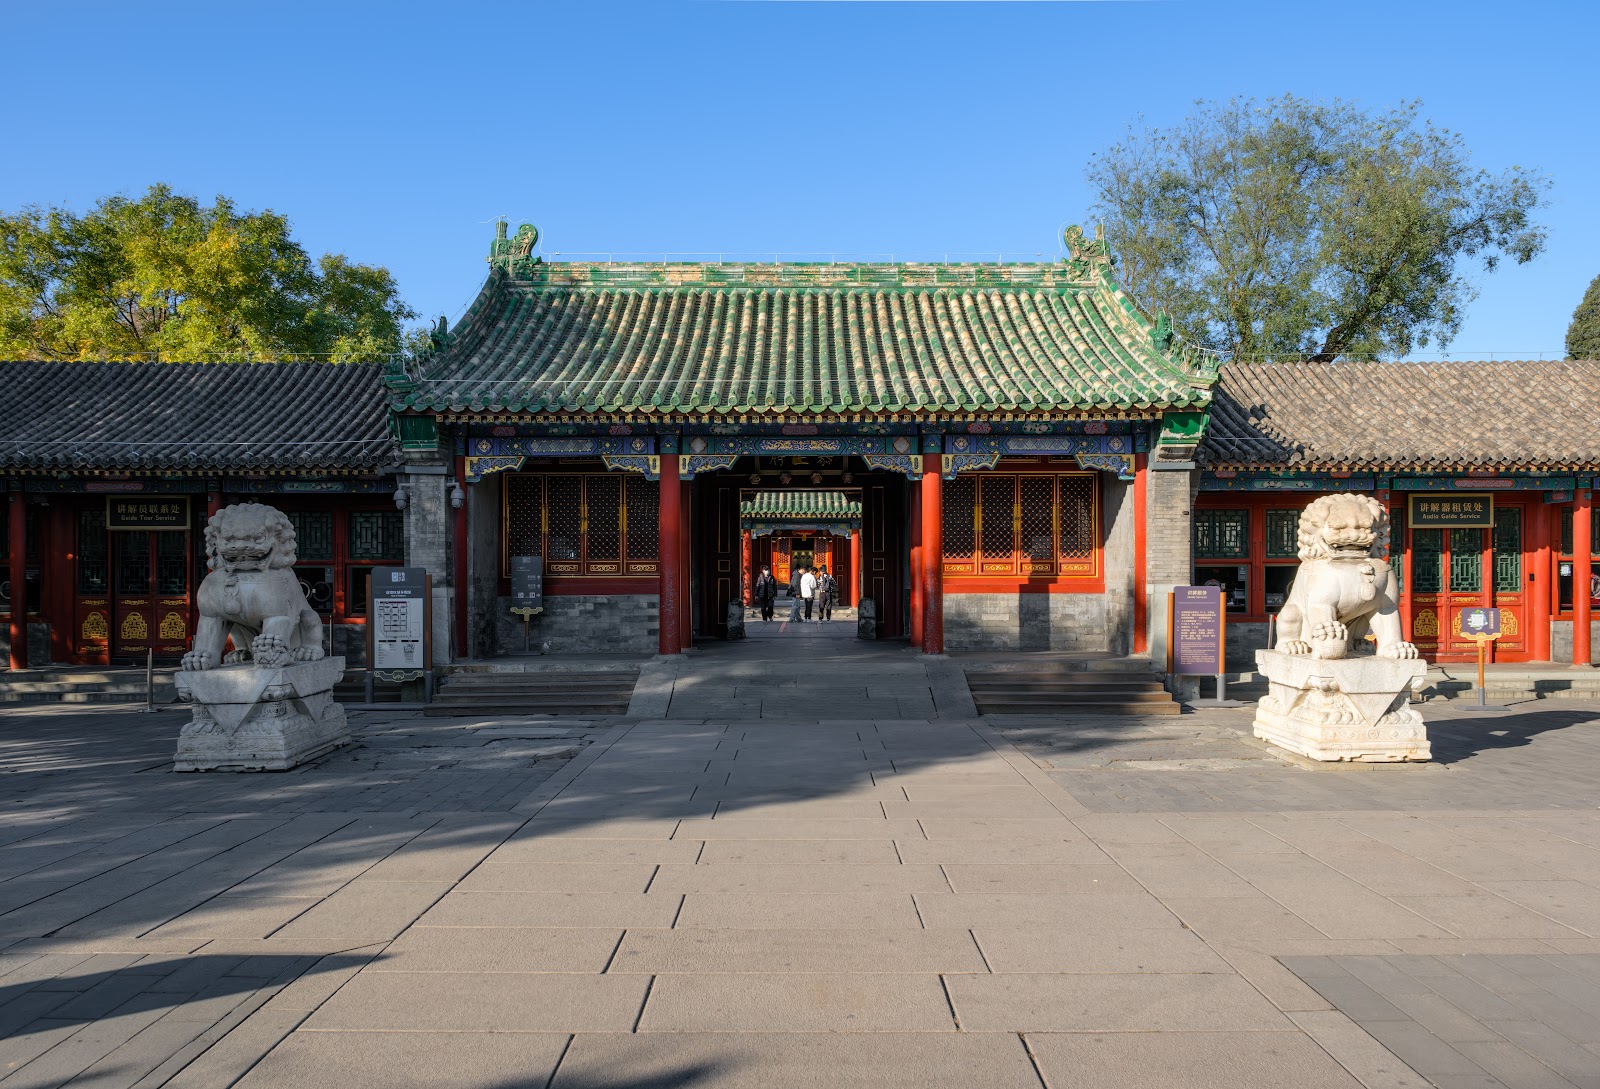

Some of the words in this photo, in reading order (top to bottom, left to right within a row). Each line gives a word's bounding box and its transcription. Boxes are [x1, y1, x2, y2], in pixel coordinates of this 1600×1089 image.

[117, 504, 180, 514] 讲解员联系处
[1420, 502, 1483, 512] 讲解器租赁处
